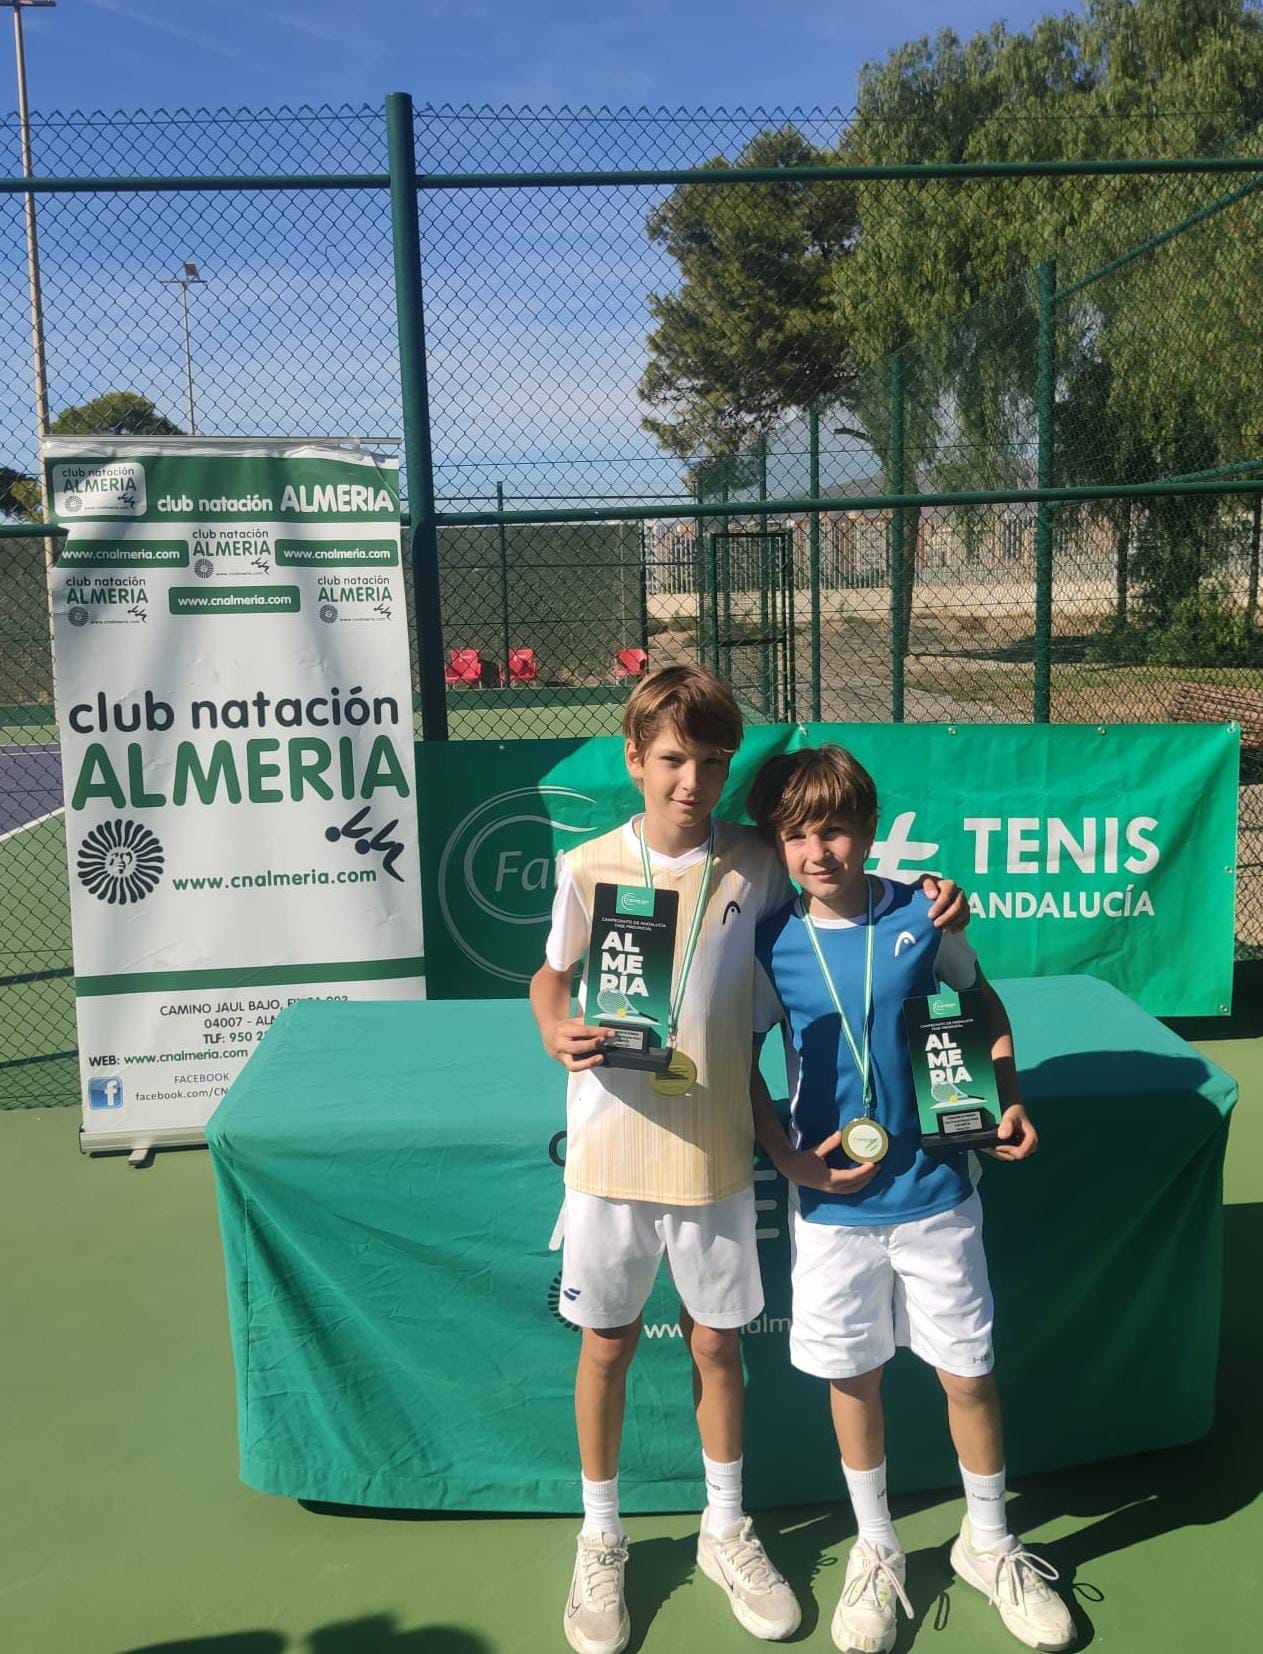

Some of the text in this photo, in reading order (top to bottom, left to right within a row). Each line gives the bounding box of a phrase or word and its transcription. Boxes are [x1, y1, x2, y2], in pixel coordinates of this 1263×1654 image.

[62, 466, 134, 477] club natación
[64, 477, 137, 494] ALMERIA
[157, 484, 394, 513] club natación ALMERIA
[192, 529, 269, 539] club natación
[62, 549, 180, 560] www.cnalmeria.com
[193, 540, 272, 556] ALMERIA
[284, 548, 390, 559] www.cnalmeria.com
[66, 576, 146, 586] club natación
[317, 575, 390, 585] club natación
[66, 588, 148, 604] ALMERIA
[178, 594, 292, 606] www.cnalmeria.com
[318, 586, 392, 602] ALMERIA
[69, 686, 399, 733] club natación
[72, 734, 410, 811] ALMERIA
[963, 816, 1160, 874] TENIS
[172, 868, 377, 890] www.cnalmeria.com
[969, 884, 1156, 919] ANDALUCÍA
[601, 931, 640, 953] AL
[601, 952, 644, 975] ME
[160, 1002, 212, 1016] CAMINO
[215, 1001, 245, 1014] JAUL
[248, 999, 283, 1012] BAJO,
[204, 1017, 242, 1029] 04007
[203, 1033, 226, 1044] TLF:
[230, 1032, 252, 1043] 950
[925, 1032, 957, 1051] AL
[88, 1048, 248, 1067] WEB: www.cnalmeria.com
[926, 1049, 964, 1068] ME
[174, 1072, 230, 1084] FACEBOOK
